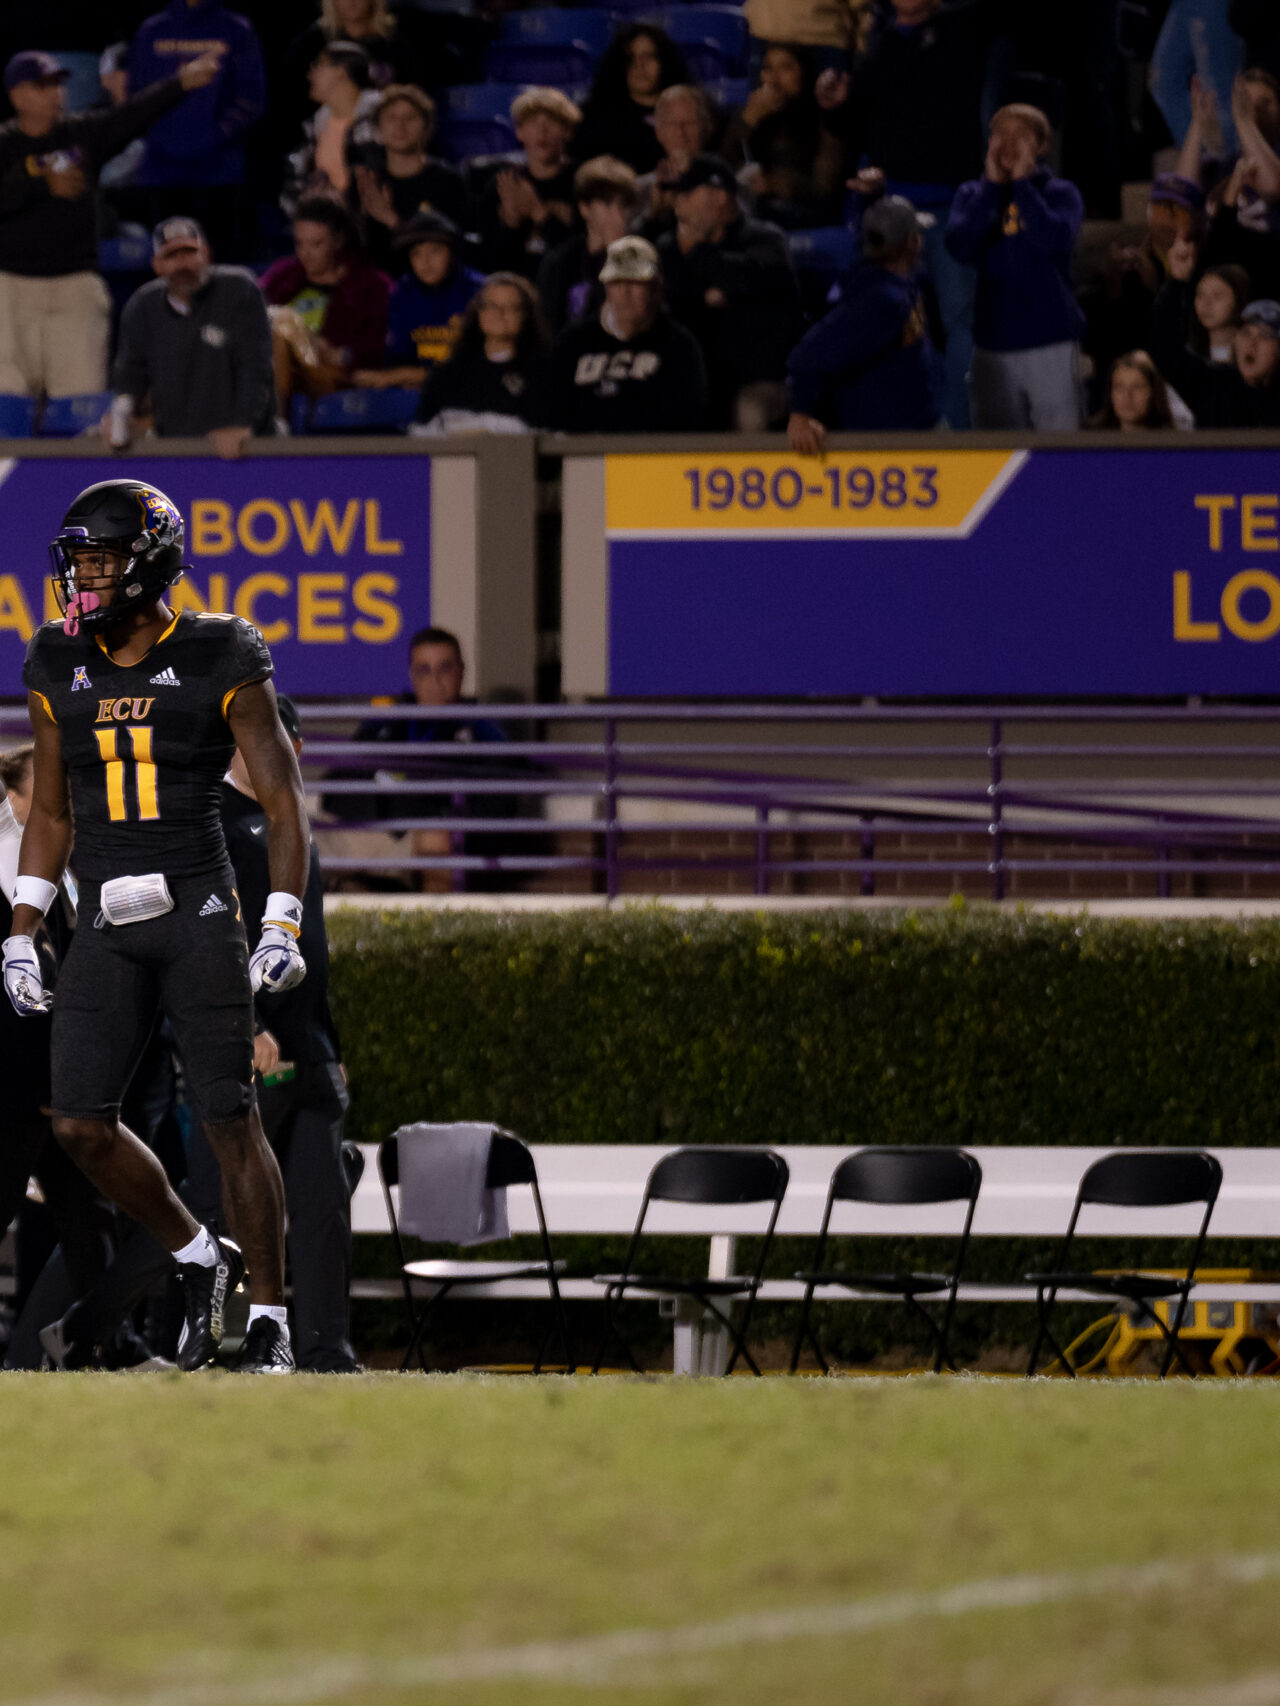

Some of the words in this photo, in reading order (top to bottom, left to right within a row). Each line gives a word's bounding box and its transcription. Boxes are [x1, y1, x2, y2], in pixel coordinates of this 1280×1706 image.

[685, 466, 939, 511] 1980-1983
[190, 498, 403, 556] BOWL
[1194, 493, 1280, 552] TE
[1173, 568, 1280, 643] LO
[94, 697, 156, 723] ECU
[149, 676, 181, 687] adidas
[92, 725, 161, 822] 11
[198, 903, 229, 917] adidas
[210, 1263, 230, 1343] ADIZERO
